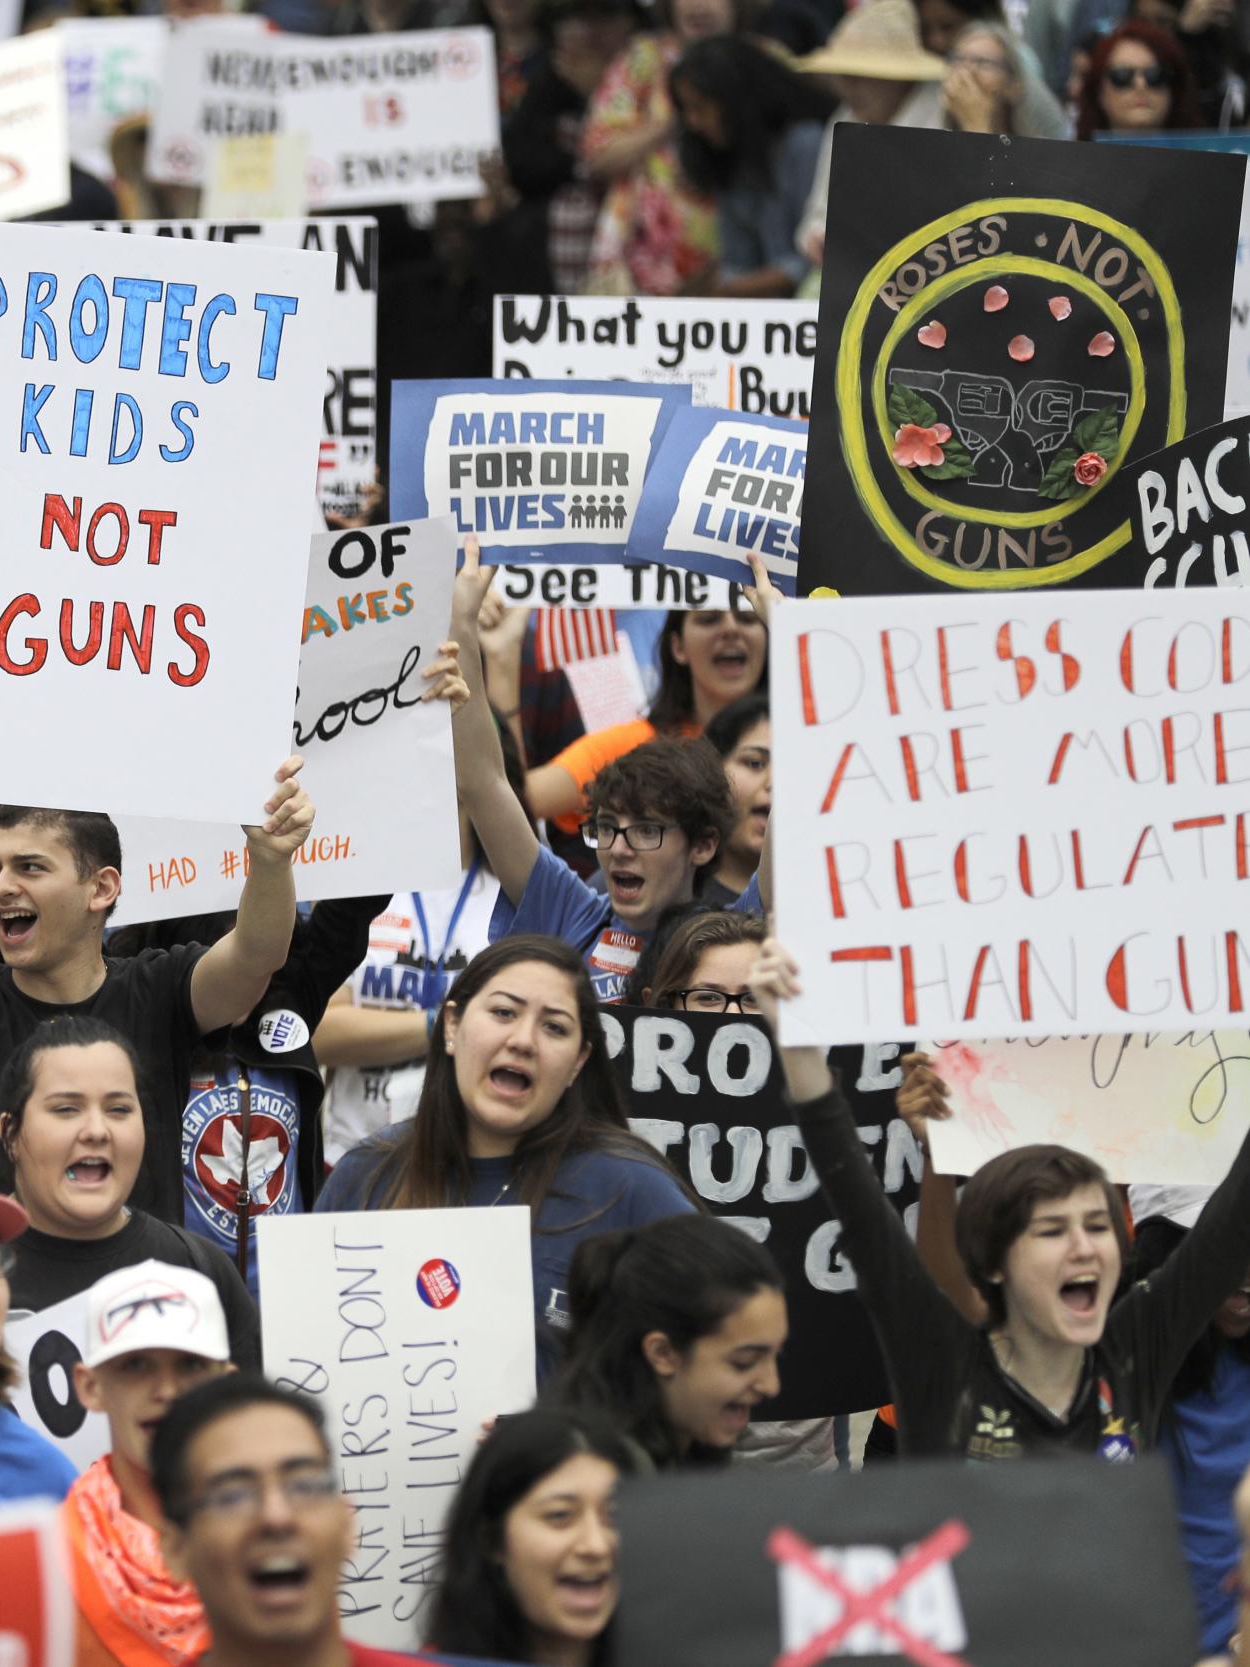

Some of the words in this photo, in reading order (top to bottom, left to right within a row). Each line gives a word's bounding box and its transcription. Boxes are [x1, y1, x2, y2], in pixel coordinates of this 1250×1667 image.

[877, 214, 1008, 314] ROSES
[1055, 220, 1156, 304] NOT
[500, 300, 642, 346] What
[657, 316, 749, 369] you
[19, 383, 199, 465] KIDS
[448, 412, 606, 446] MARCH
[449, 452, 533, 489] FOR
[539, 452, 631, 488] OUR
[704, 468, 798, 512] FOR
[39, 493, 178, 567] NOT
[449, 494, 567, 532] LIVES
[915, 509, 1073, 572] GUNS
[328, 525, 412, 580] OF
[796, 615, 1083, 728] DRESS
[818, 722, 997, 816] ARE
[1046, 706, 1250, 787] MORE
[149, 856, 197, 893] HAD
[609, 931, 637, 948] HELLO
[829, 935, 1080, 1028] THAN
[269, 1012, 296, 1050] VOTE
[198, 1091, 240, 1123] LAES
[334, 1226, 390, 1363] DONT
[401, 1340, 461, 1489] LIVES!
